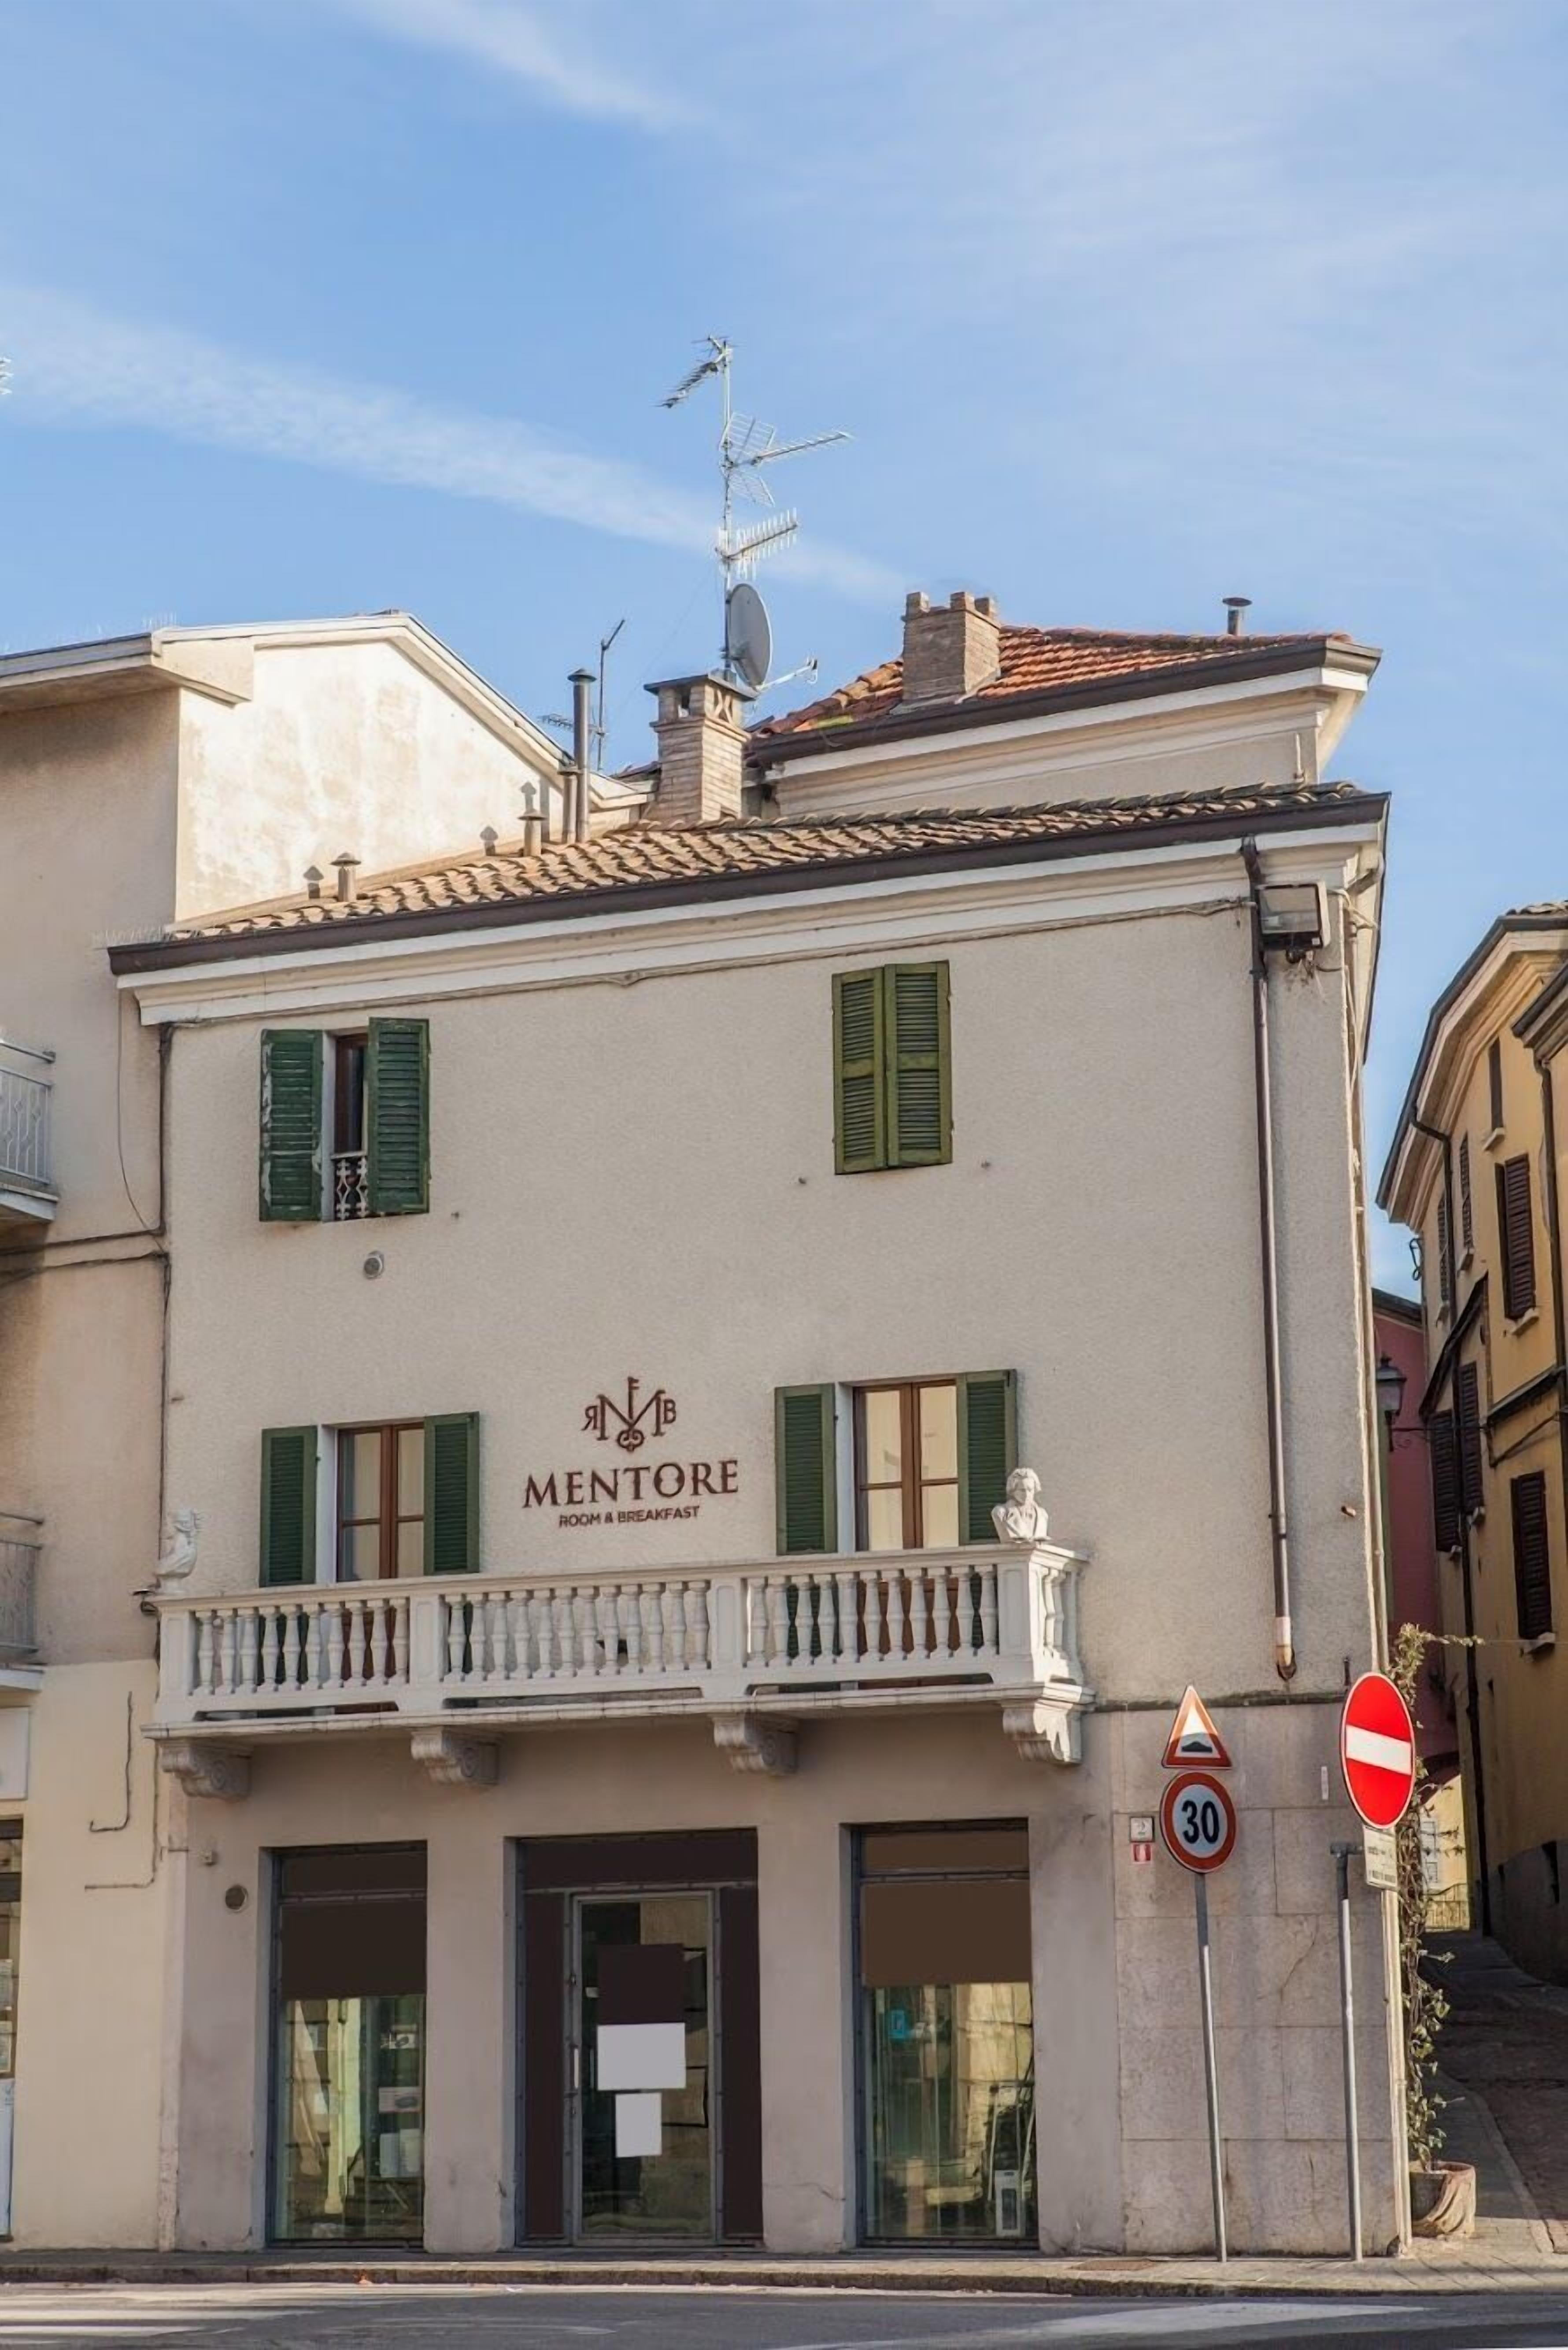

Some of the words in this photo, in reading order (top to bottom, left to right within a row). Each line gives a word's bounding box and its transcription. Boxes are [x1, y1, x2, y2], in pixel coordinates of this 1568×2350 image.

[522, 1459, 739, 1508] MENTORE
[559, 1513, 601, 1528] ROOM
[617, 1505, 700, 1523] BREAKFAST
[1182, 1800, 1220, 1844] 30
